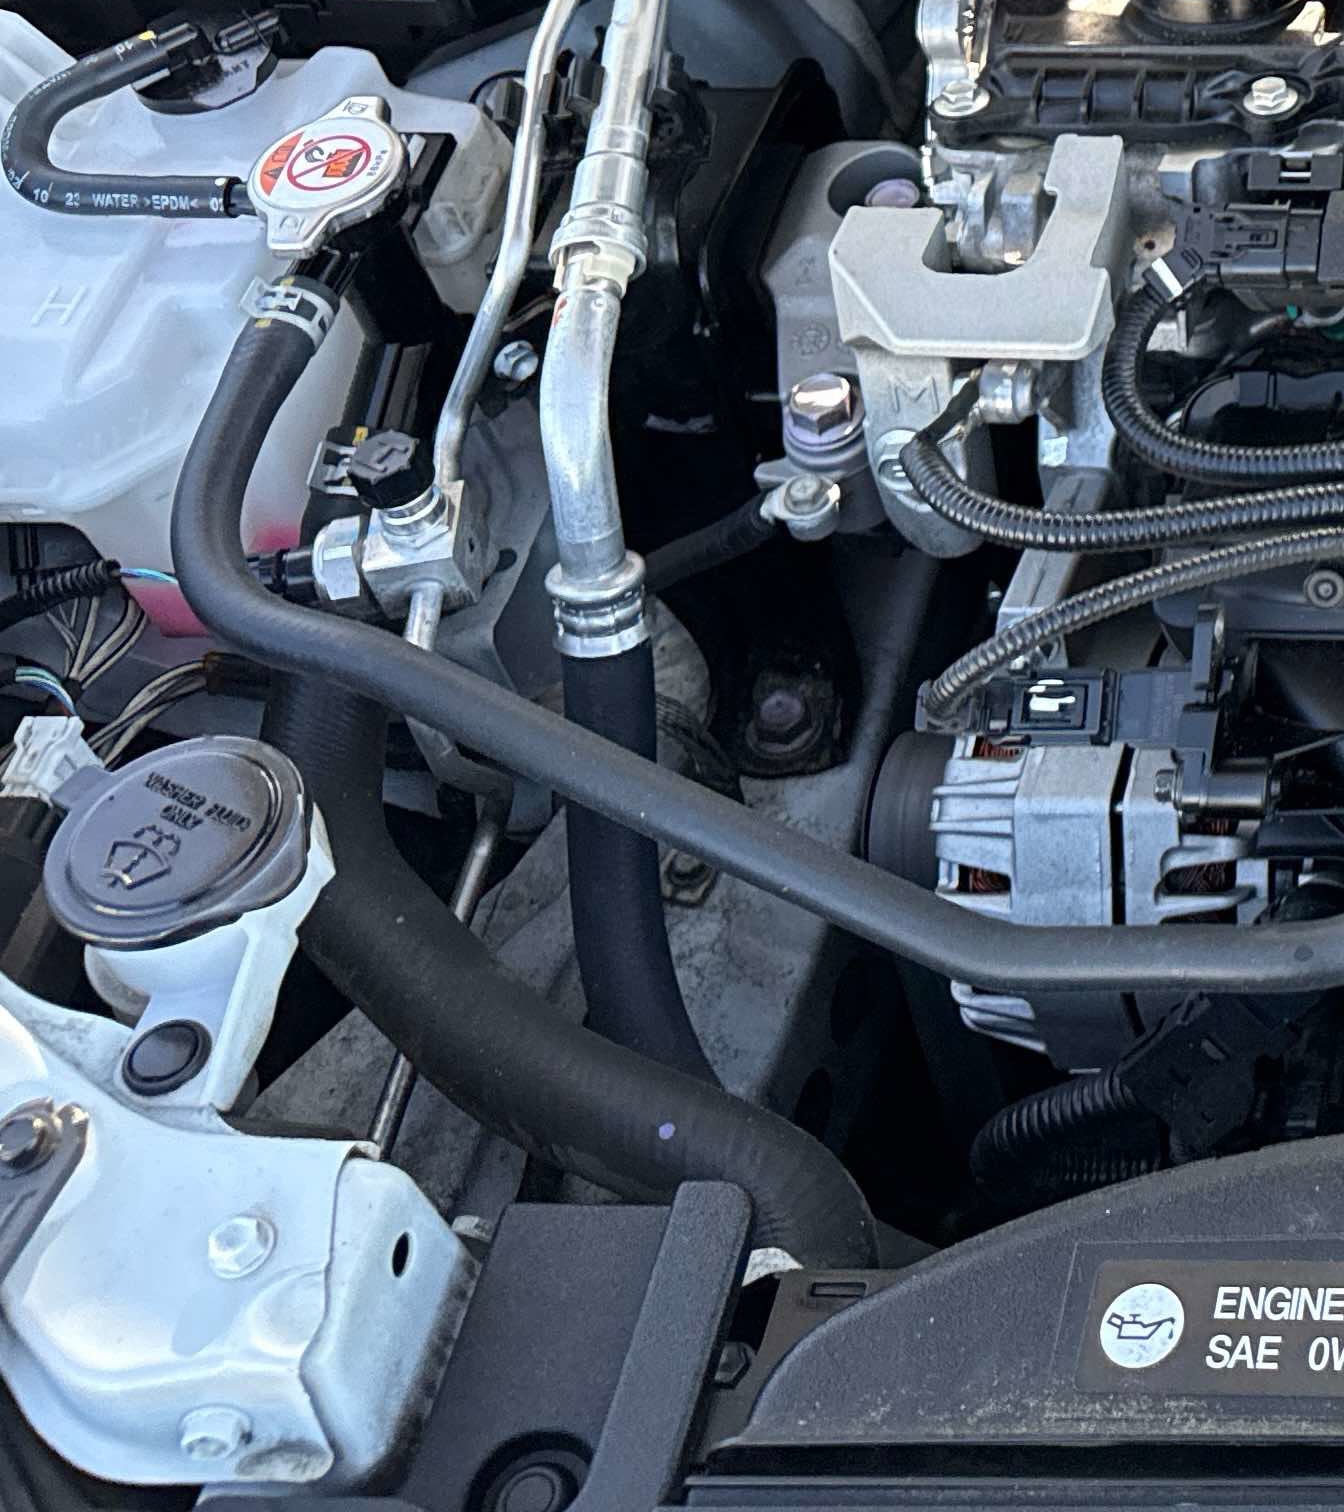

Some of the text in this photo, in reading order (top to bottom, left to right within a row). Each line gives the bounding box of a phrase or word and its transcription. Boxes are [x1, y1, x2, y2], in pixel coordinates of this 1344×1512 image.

[91, 192, 139, 209] WATER
[143, 193, 200, 212] >EPDM<
[887, 375, 942, 416] M
[1205, 1334, 1282, 1369] SAE
